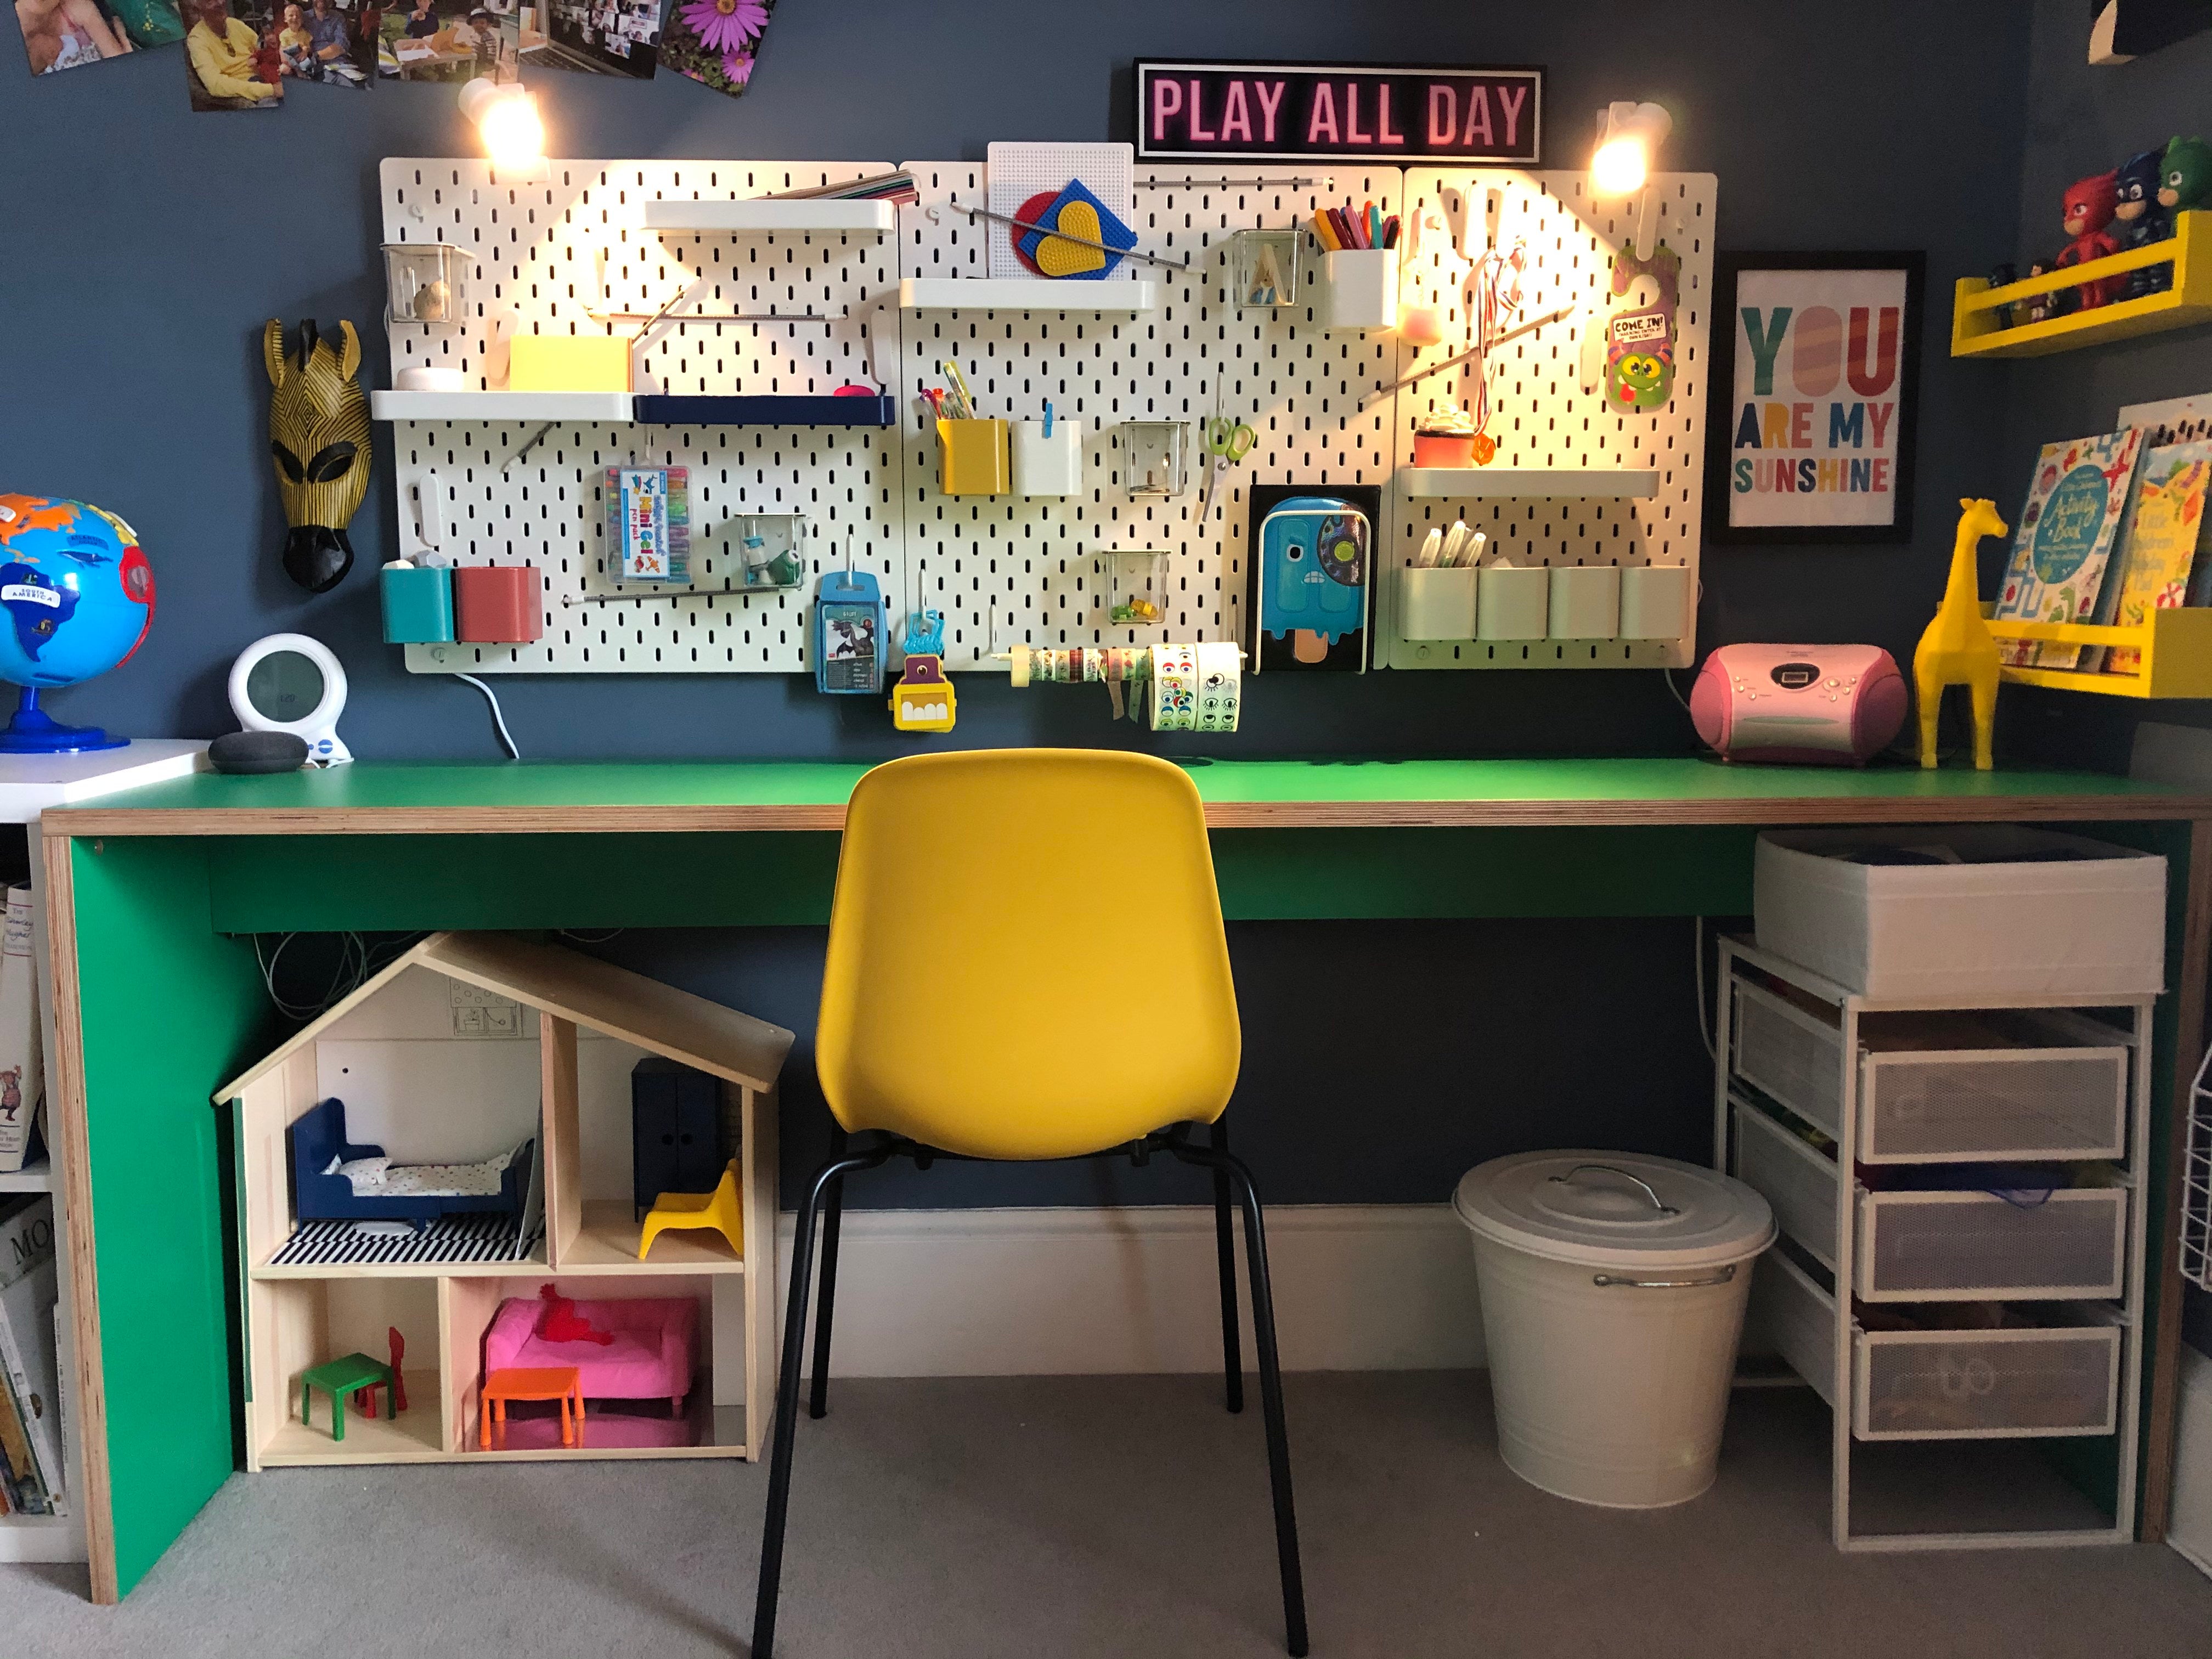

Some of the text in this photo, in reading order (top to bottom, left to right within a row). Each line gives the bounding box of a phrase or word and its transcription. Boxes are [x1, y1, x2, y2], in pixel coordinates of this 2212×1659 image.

[1153, 78, 1527, 147] PLAY ALL DAY
[1615, 316, 1663, 332] COME IN!
[1740, 305, 1900, 397] YOU
[1734, 402, 1895, 449] ARE MY
[1734, 458, 1889, 493] SUNSHINE
[629, 508, 640, 541] pen pack
[639, 496, 654, 554] Mini Gel
[12, 592, 52, 602] AMERICA
